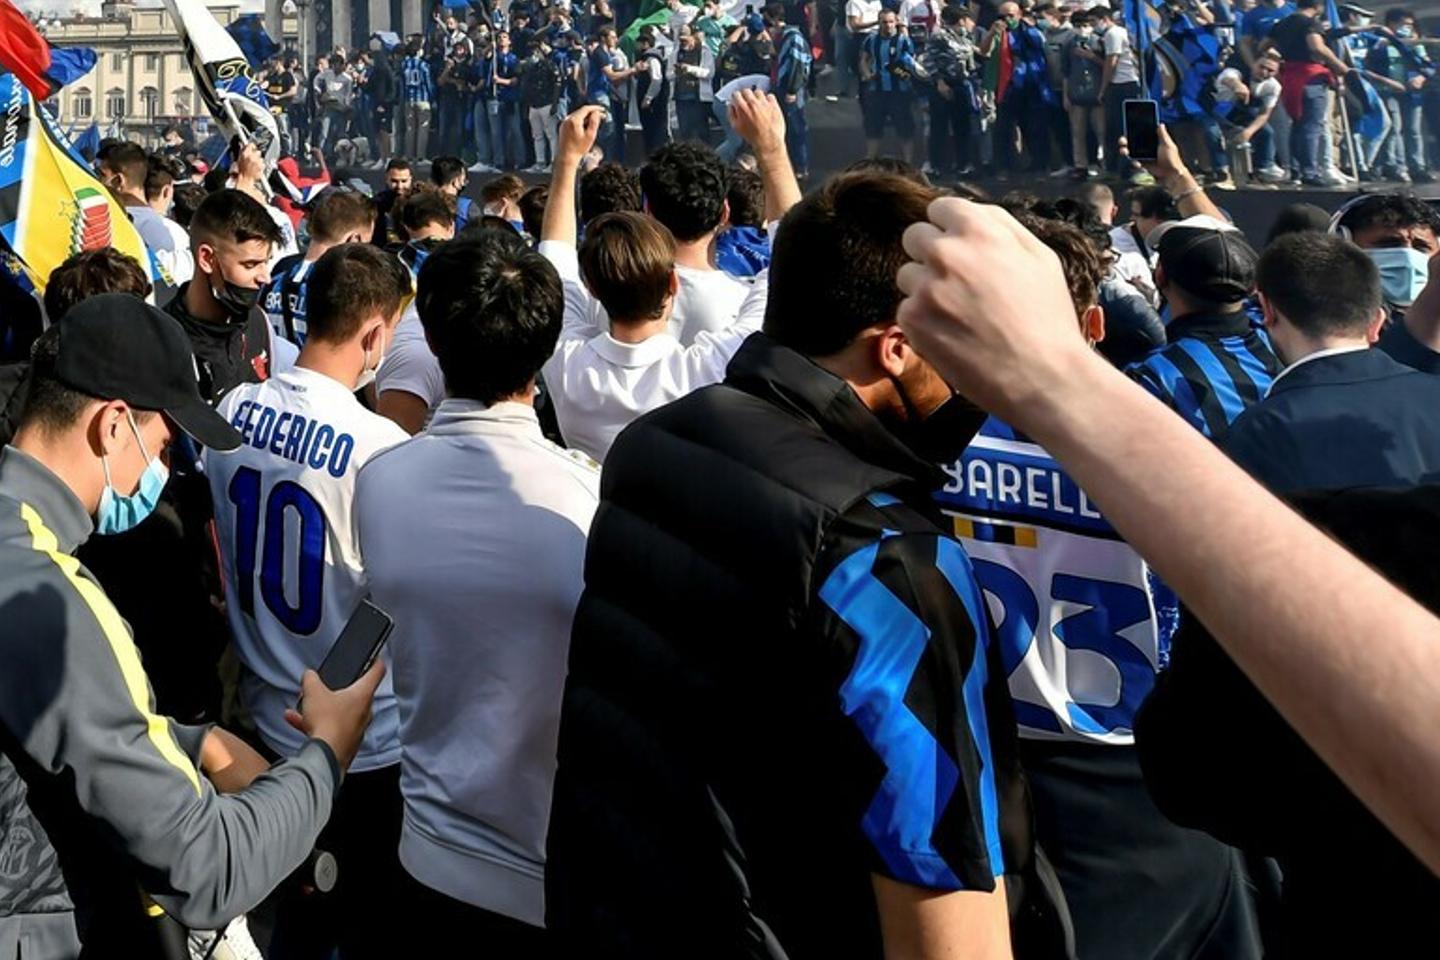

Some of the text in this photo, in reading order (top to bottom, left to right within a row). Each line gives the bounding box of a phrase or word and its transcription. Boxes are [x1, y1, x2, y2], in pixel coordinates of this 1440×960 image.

[231, 400, 354, 478] FEDERICO
[941, 458, 1102, 520] BARELL
[229, 465, 325, 637] 10
